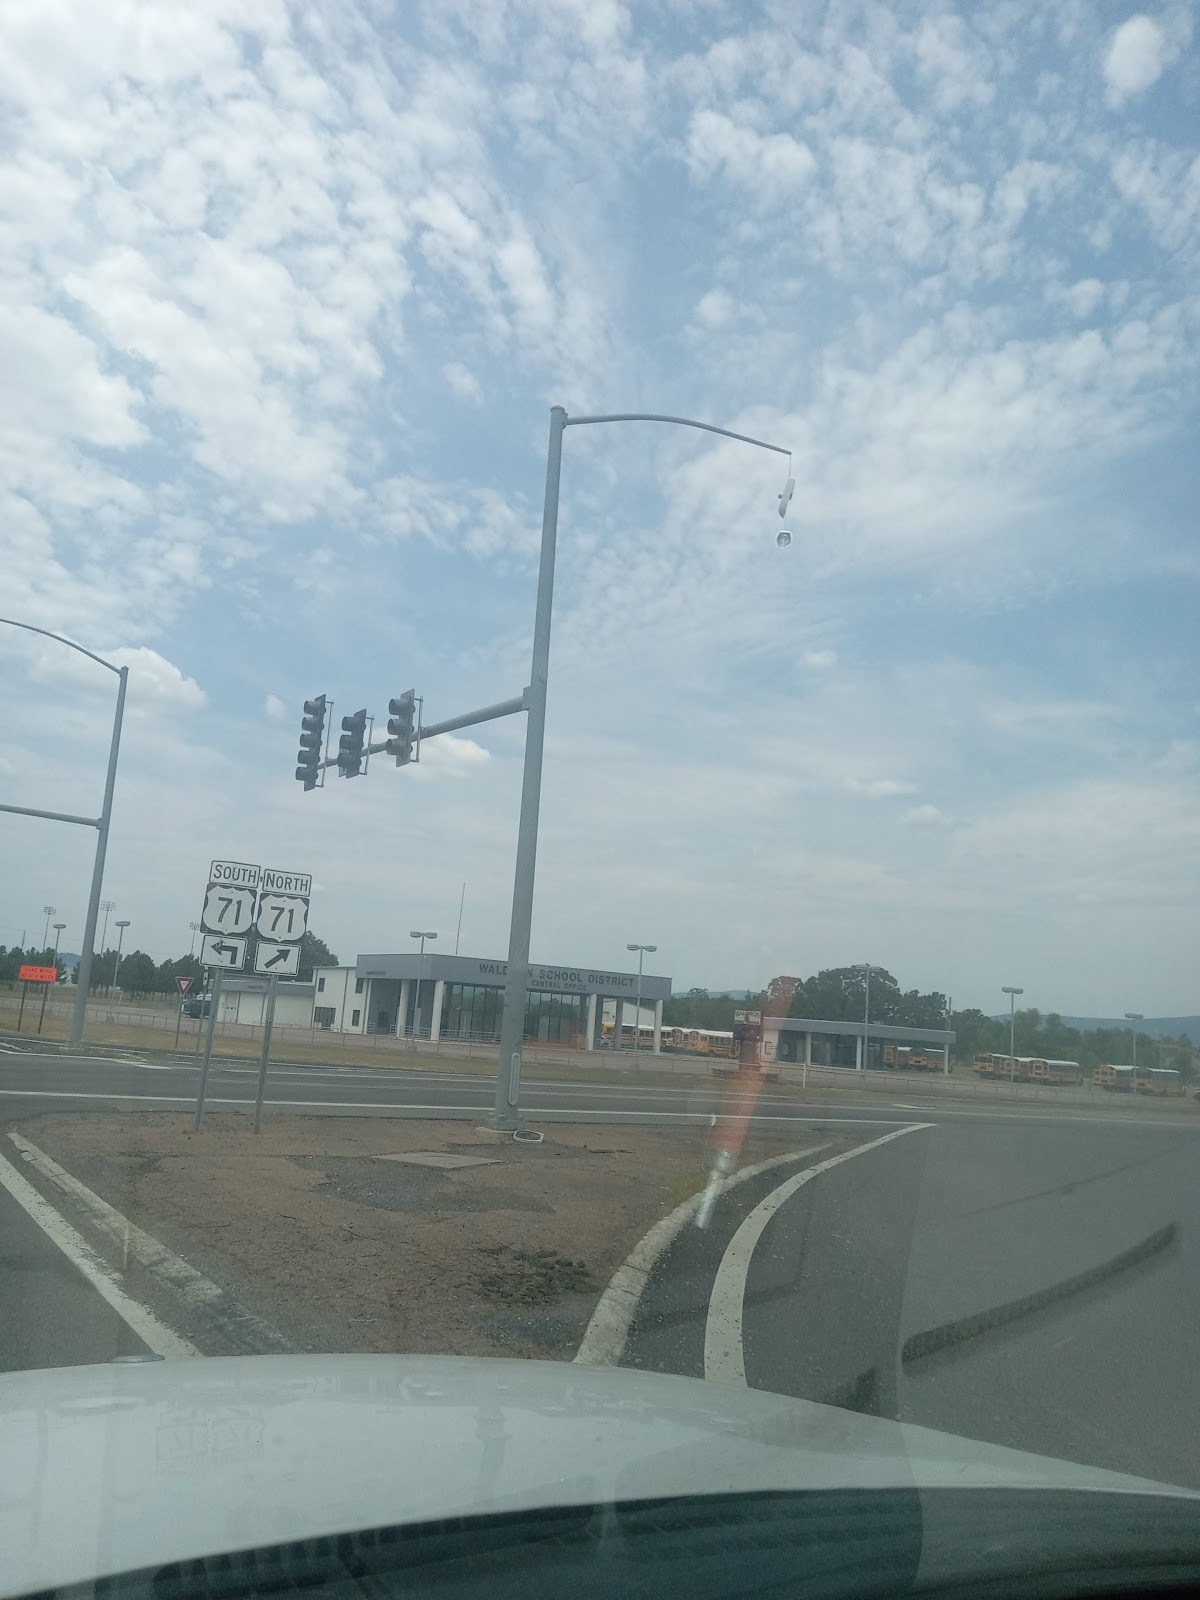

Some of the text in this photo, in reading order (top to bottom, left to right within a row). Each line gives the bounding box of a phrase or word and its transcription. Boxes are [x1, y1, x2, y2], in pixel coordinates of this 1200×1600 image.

[214, 864, 257, 884] SOUTH
[266, 873, 309, 892] NORTH
[218, 897, 243, 926] 71
[270, 906, 295, 934] 71
[479, 963, 635, 988] WALDN SCHOOL DISTRICT
[531, 979, 587, 991] CENTRAL OFFICE
